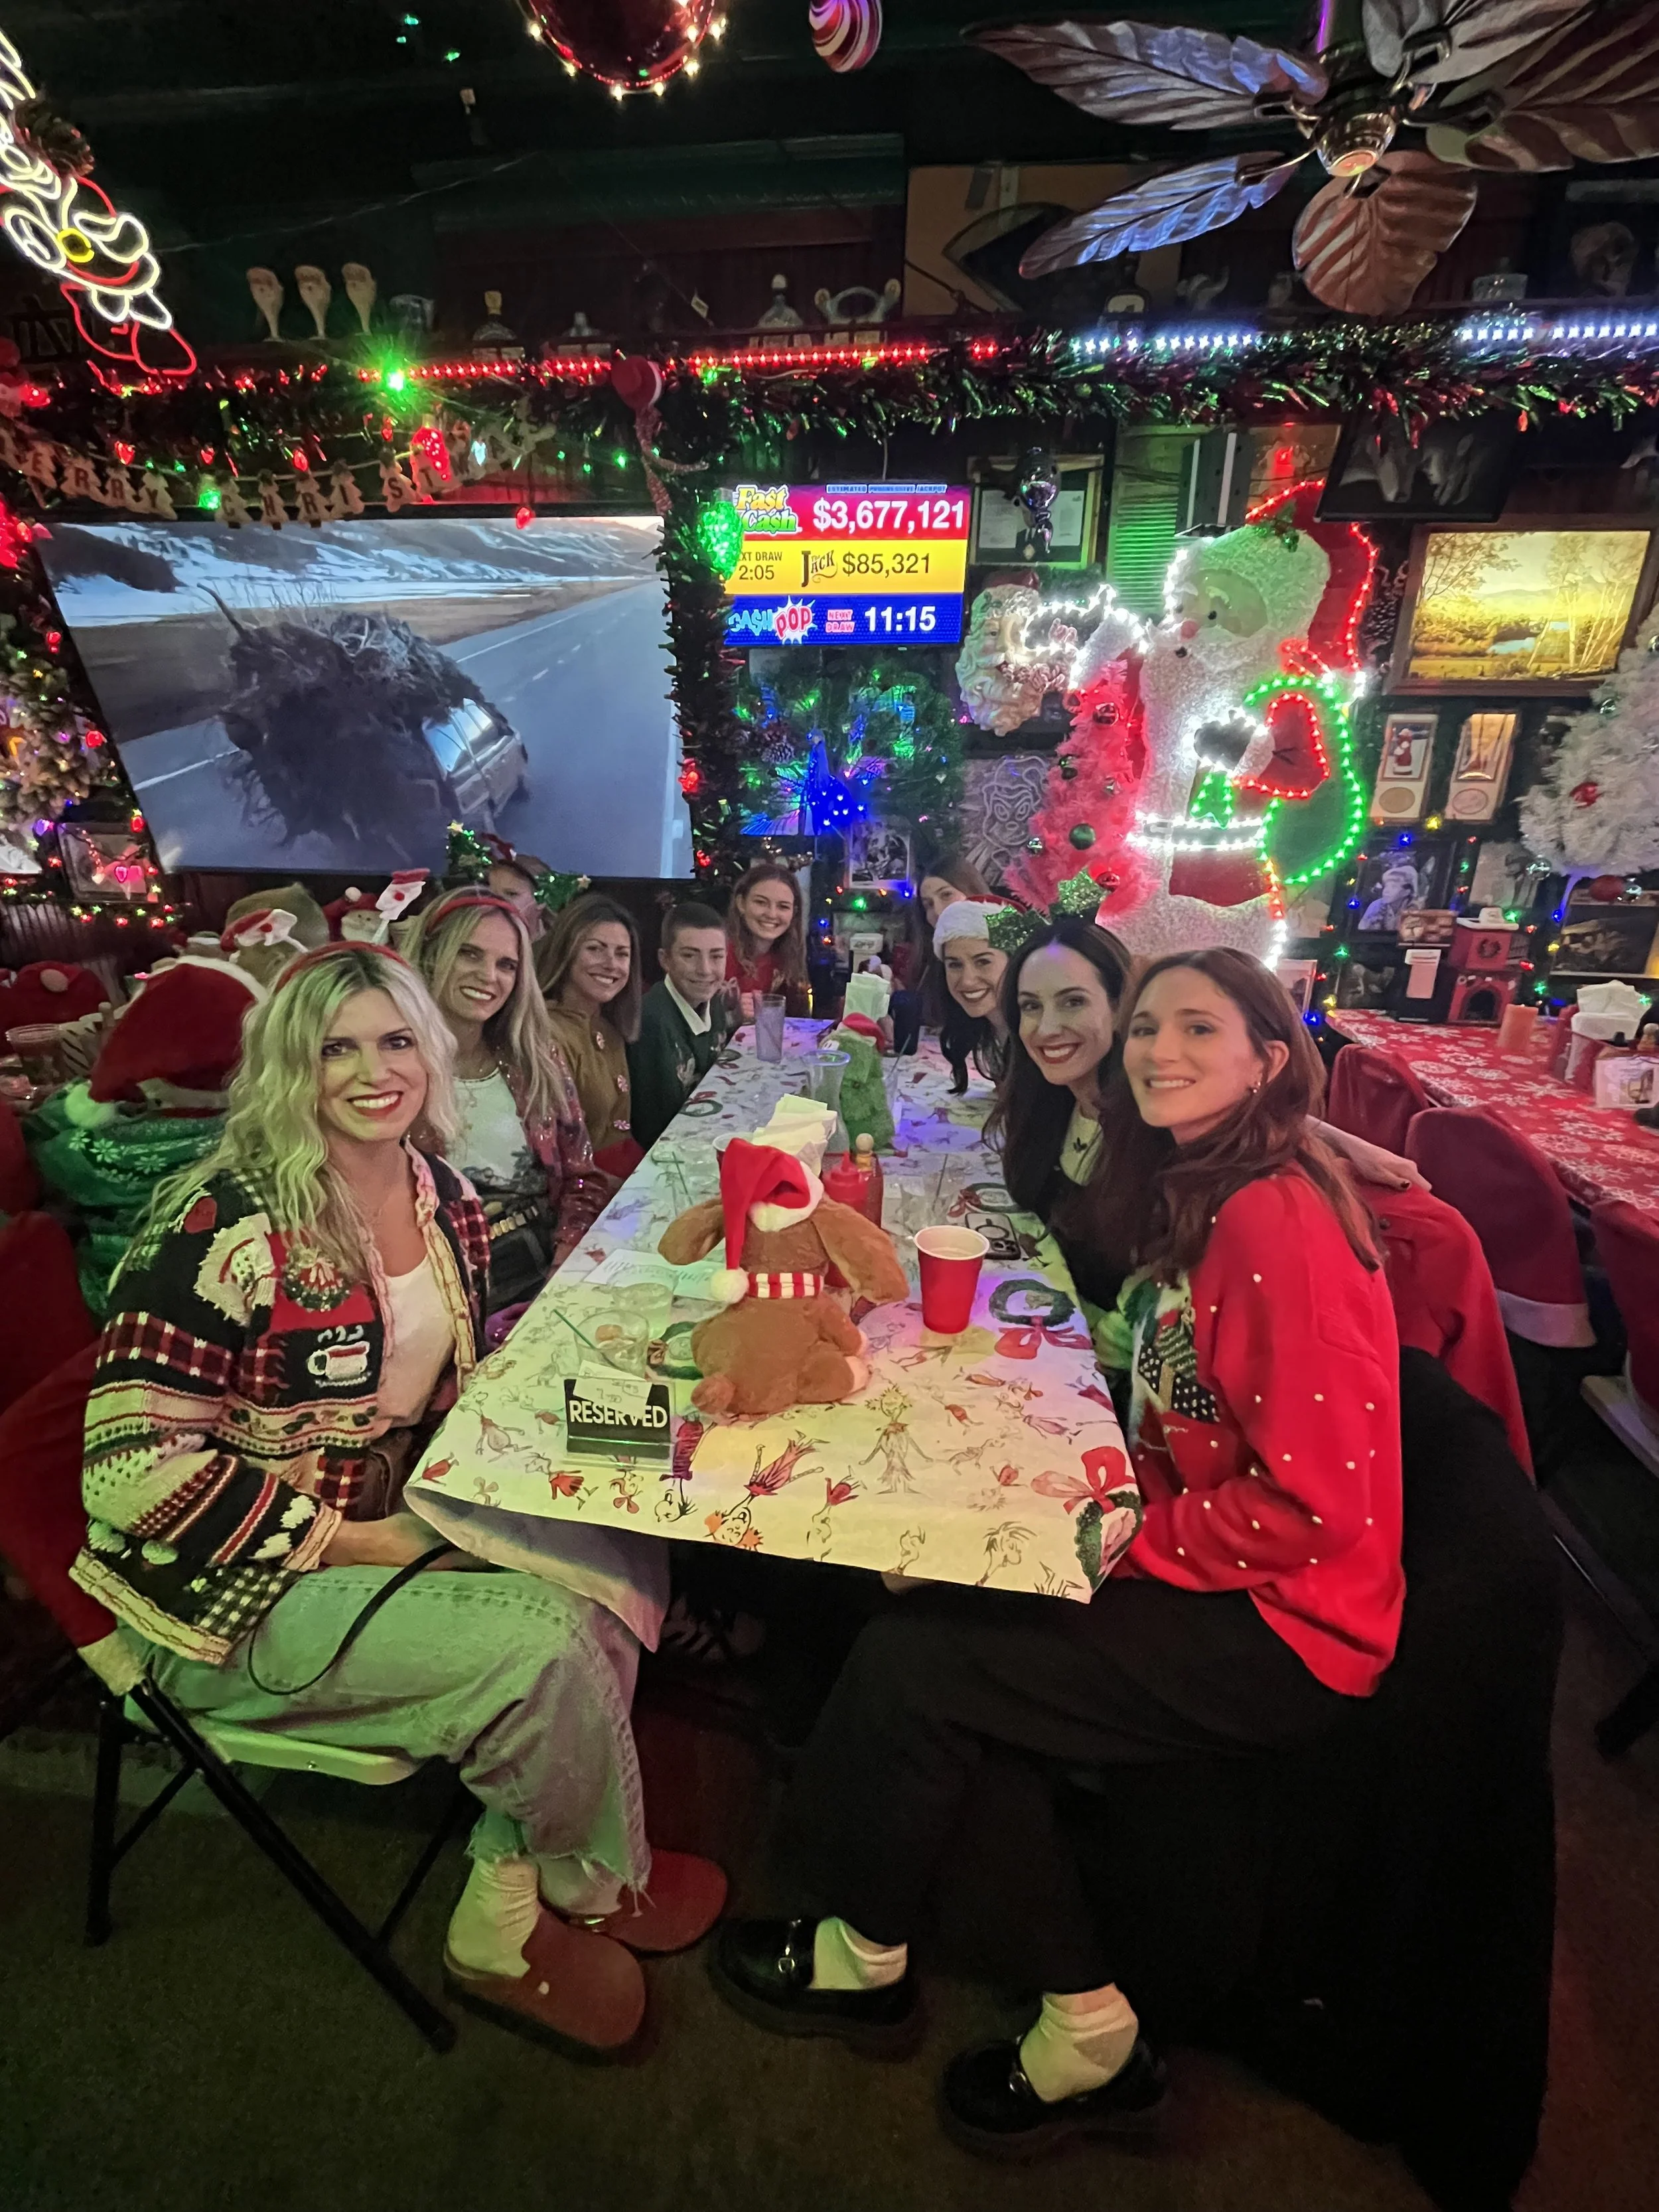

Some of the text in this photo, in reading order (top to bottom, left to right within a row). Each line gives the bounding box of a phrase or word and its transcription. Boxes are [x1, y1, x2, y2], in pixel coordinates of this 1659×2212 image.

[813, 497, 964, 534] $3,677,121
[737, 552, 783, 561] XT DRAW
[801, 550, 835, 587] JACK
[843, 552, 931, 577] $85,321
[739, 564, 775, 580] 2:05
[775, 605, 813, 640] POP
[826, 623, 853, 632] DRAW
[828, 611, 852, 620] NEXT
[865, 605, 936, 632] 11:15
